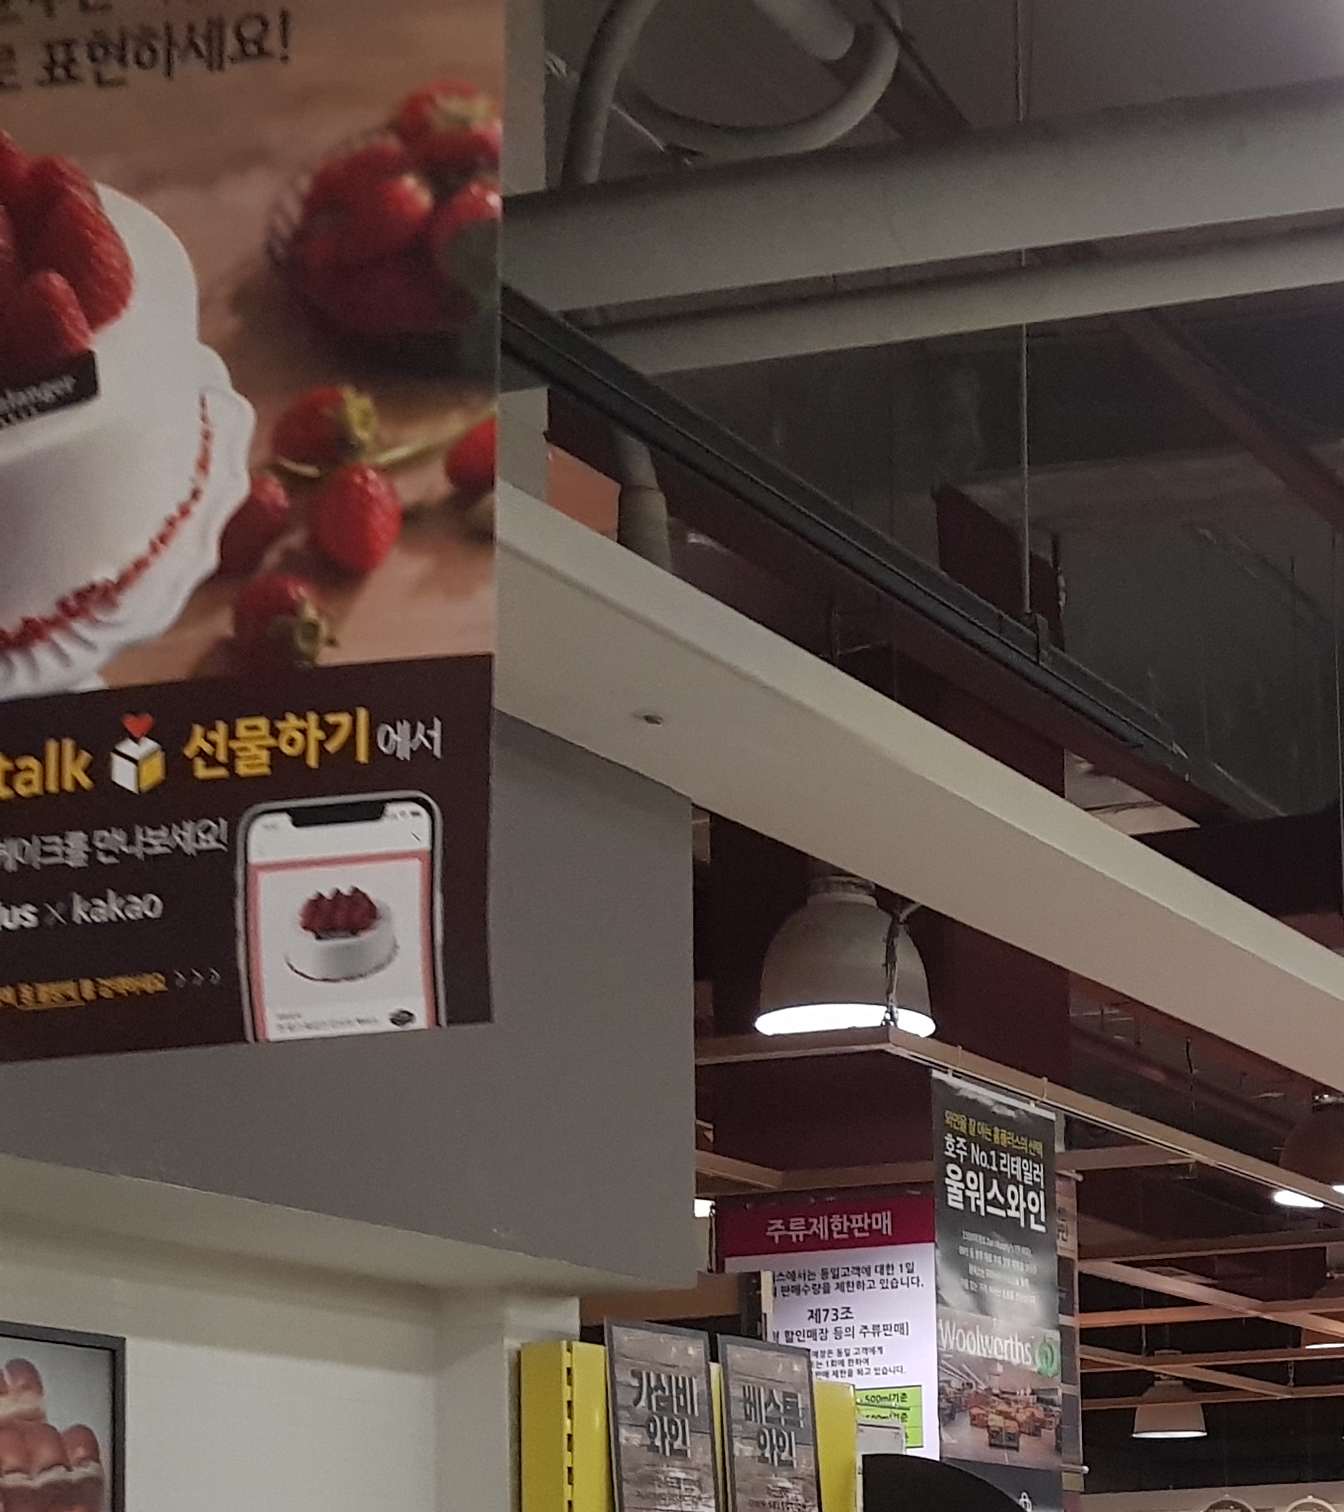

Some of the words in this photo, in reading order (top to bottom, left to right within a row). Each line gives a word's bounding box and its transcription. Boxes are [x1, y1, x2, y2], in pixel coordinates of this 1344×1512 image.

[36, 12, 293, 87] 표현하세요!
[71, 890, 166, 926] kakao
[943, 1133, 968, 1165] 호주
[970, 1142, 998, 1172] No.1
[999, 1152, 1045, 1190] 리테일러
[943, 1162, 1048, 1233] 울워스와인
[765, 1210, 893, 1245] 주류제한판매
[874, 1262, 895, 1275] 대한
[898, 1261, 916, 1274] 1일
[879, 1275, 925, 1290] 있습니다.
[806, 1306, 855, 1325] 제73조
[783, 1327, 829, 1344] 할인매장
[832, 1325, 855, 1341] 등의
[937, 1317, 1033, 1367] Woolworths
